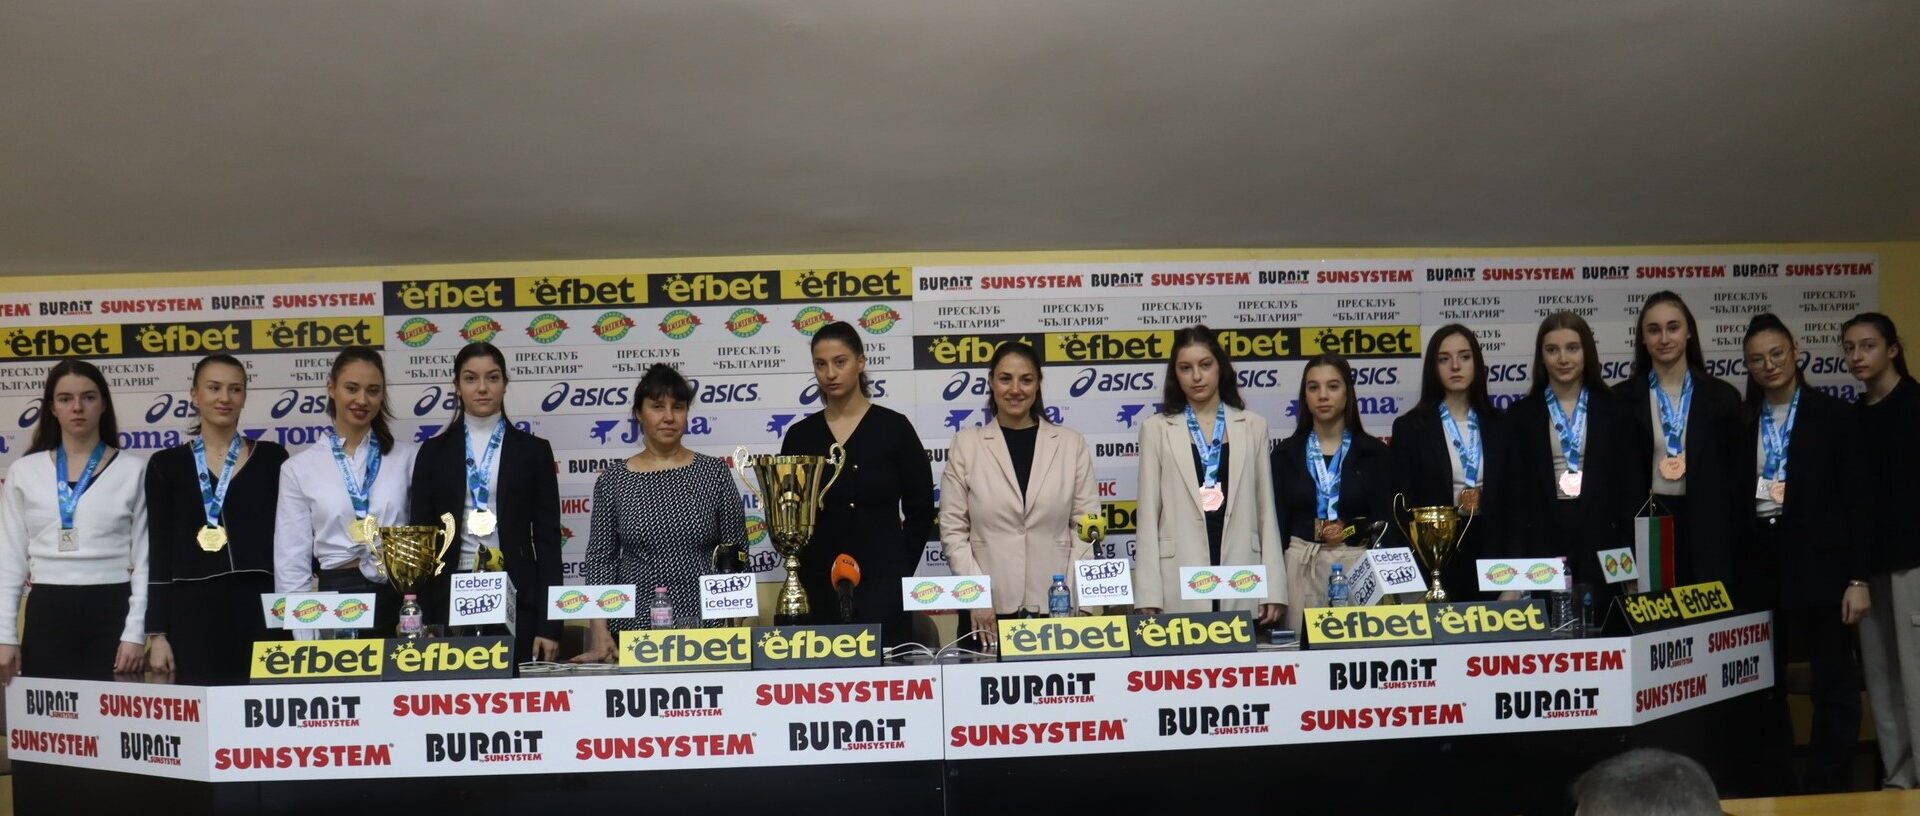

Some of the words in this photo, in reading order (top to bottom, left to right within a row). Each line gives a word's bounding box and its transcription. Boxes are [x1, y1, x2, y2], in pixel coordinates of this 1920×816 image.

[980, 274, 1082, 289] SUNSYSTEM
[1151, 271, 1250, 286] SUNSYSTEM
[1317, 269, 1413, 283] SUNSYSTEM
[1482, 267, 1575, 281] SUNSYSTEM
[1636, 265, 1726, 279] SUNSYSTEM
[1785, 263, 1873, 276] SUNSYSTEM
[535, 277, 636, 306] efbet
[667, 274, 770, 302] efbet
[803, 269, 902, 299] efbet
[100, 297, 203, 314] SUNSYSTEM
[272, 292, 375, 309] SUNSYSTEM
[403, 281, 502, 310] efbet
[1337, 297, 1396, 309] ПРЕСКЛУБ
[1443, 296, 1501, 306] ПРЕСКЛУБ
[1538, 294, 1594, 304] ПРЕСКЛУБ
[1714, 291, 1768, 302] ПРЕСКЛУБ
[1803, 289, 1856, 300] ПРЕСКЛУБ
[938, 305, 1001, 316] ПРЕСКЛУБ
[1042, 303, 1105, 315] ПРЕСКЛУБ
[1142, 301, 1203, 312] ПРЕСКЛУБ
[1238, 299, 1299, 310] ПРЕСКЛУБ
[11, 323, 109, 356] efbet
[142, 323, 240, 352] efbet
[272, 319, 373, 348] efbet
[1320, 327, 1412, 355] efbet
[617, 348, 680, 359] ПРЕСКЛУБ
[717, 345, 781, 356] ПРЕСКЛУБ
[1066, 330, 1162, 360] efbet
[515, 351, 578, 362] ПРЕСКЛУБ
[1371, 551, 1411, 563] iceberg
[1080, 561, 1124, 577] Party
[1379, 566, 1417, 582] Party
[455, 576, 502, 590] iceberg
[705, 575, 751, 591] Party
[1081, 583, 1129, 596] iceberg
[455, 594, 502, 612] Party
[705, 597, 754, 609] iceberg
[1629, 592, 1678, 624] efbet
[1683, 584, 1727, 615] efbet
[1320, 609, 1430, 640] efbet
[1441, 603, 1545, 634] efbet
[1012, 621, 1125, 652] efbet
[1142, 615, 1251, 647] efbet
[1708, 622, 1770, 654] SUNSYSTEM
[634, 632, 747, 664] efbet
[765, 628, 877, 660] efbet
[265, 644, 378, 676] efbet
[397, 640, 509, 673] efbet
[1127, 664, 1297, 692] SUNSYSTEM
[1466, 651, 1624, 677] SUNSYSTEM
[1382, 680, 1437, 690] SUNSYSTEM
[1635, 675, 1707, 713] SUNSYSTEM
[393, 690, 571, 717] SUNSYSTEM
[755, 678, 934, 706] SUNSYSTEM
[1037, 694, 1095, 704] SUNSYSTEM
[100, 693, 200, 723] SUNSYSTEM
[664, 709, 722, 718] SUNSYSTEM
[1547, 709, 1599, 718] SUNSYSTEM
[302, 719, 360, 728] SUNSYSTEM
[950, 719, 1125, 748] SUNSYSTEM
[1300, 703, 1464, 731] SUNSYSTEM
[1214, 726, 1269, 735] SUNSYSTEM
[11, 728, 98, 758] SUNSYSTEM
[214, 744, 391, 770] SUNSYSTEM
[575, 733, 754, 761] SUNSYSTEM
[847, 740, 906, 750] SUNSYSTEM
[484, 753, 542, 762] SUNSYSTEM
